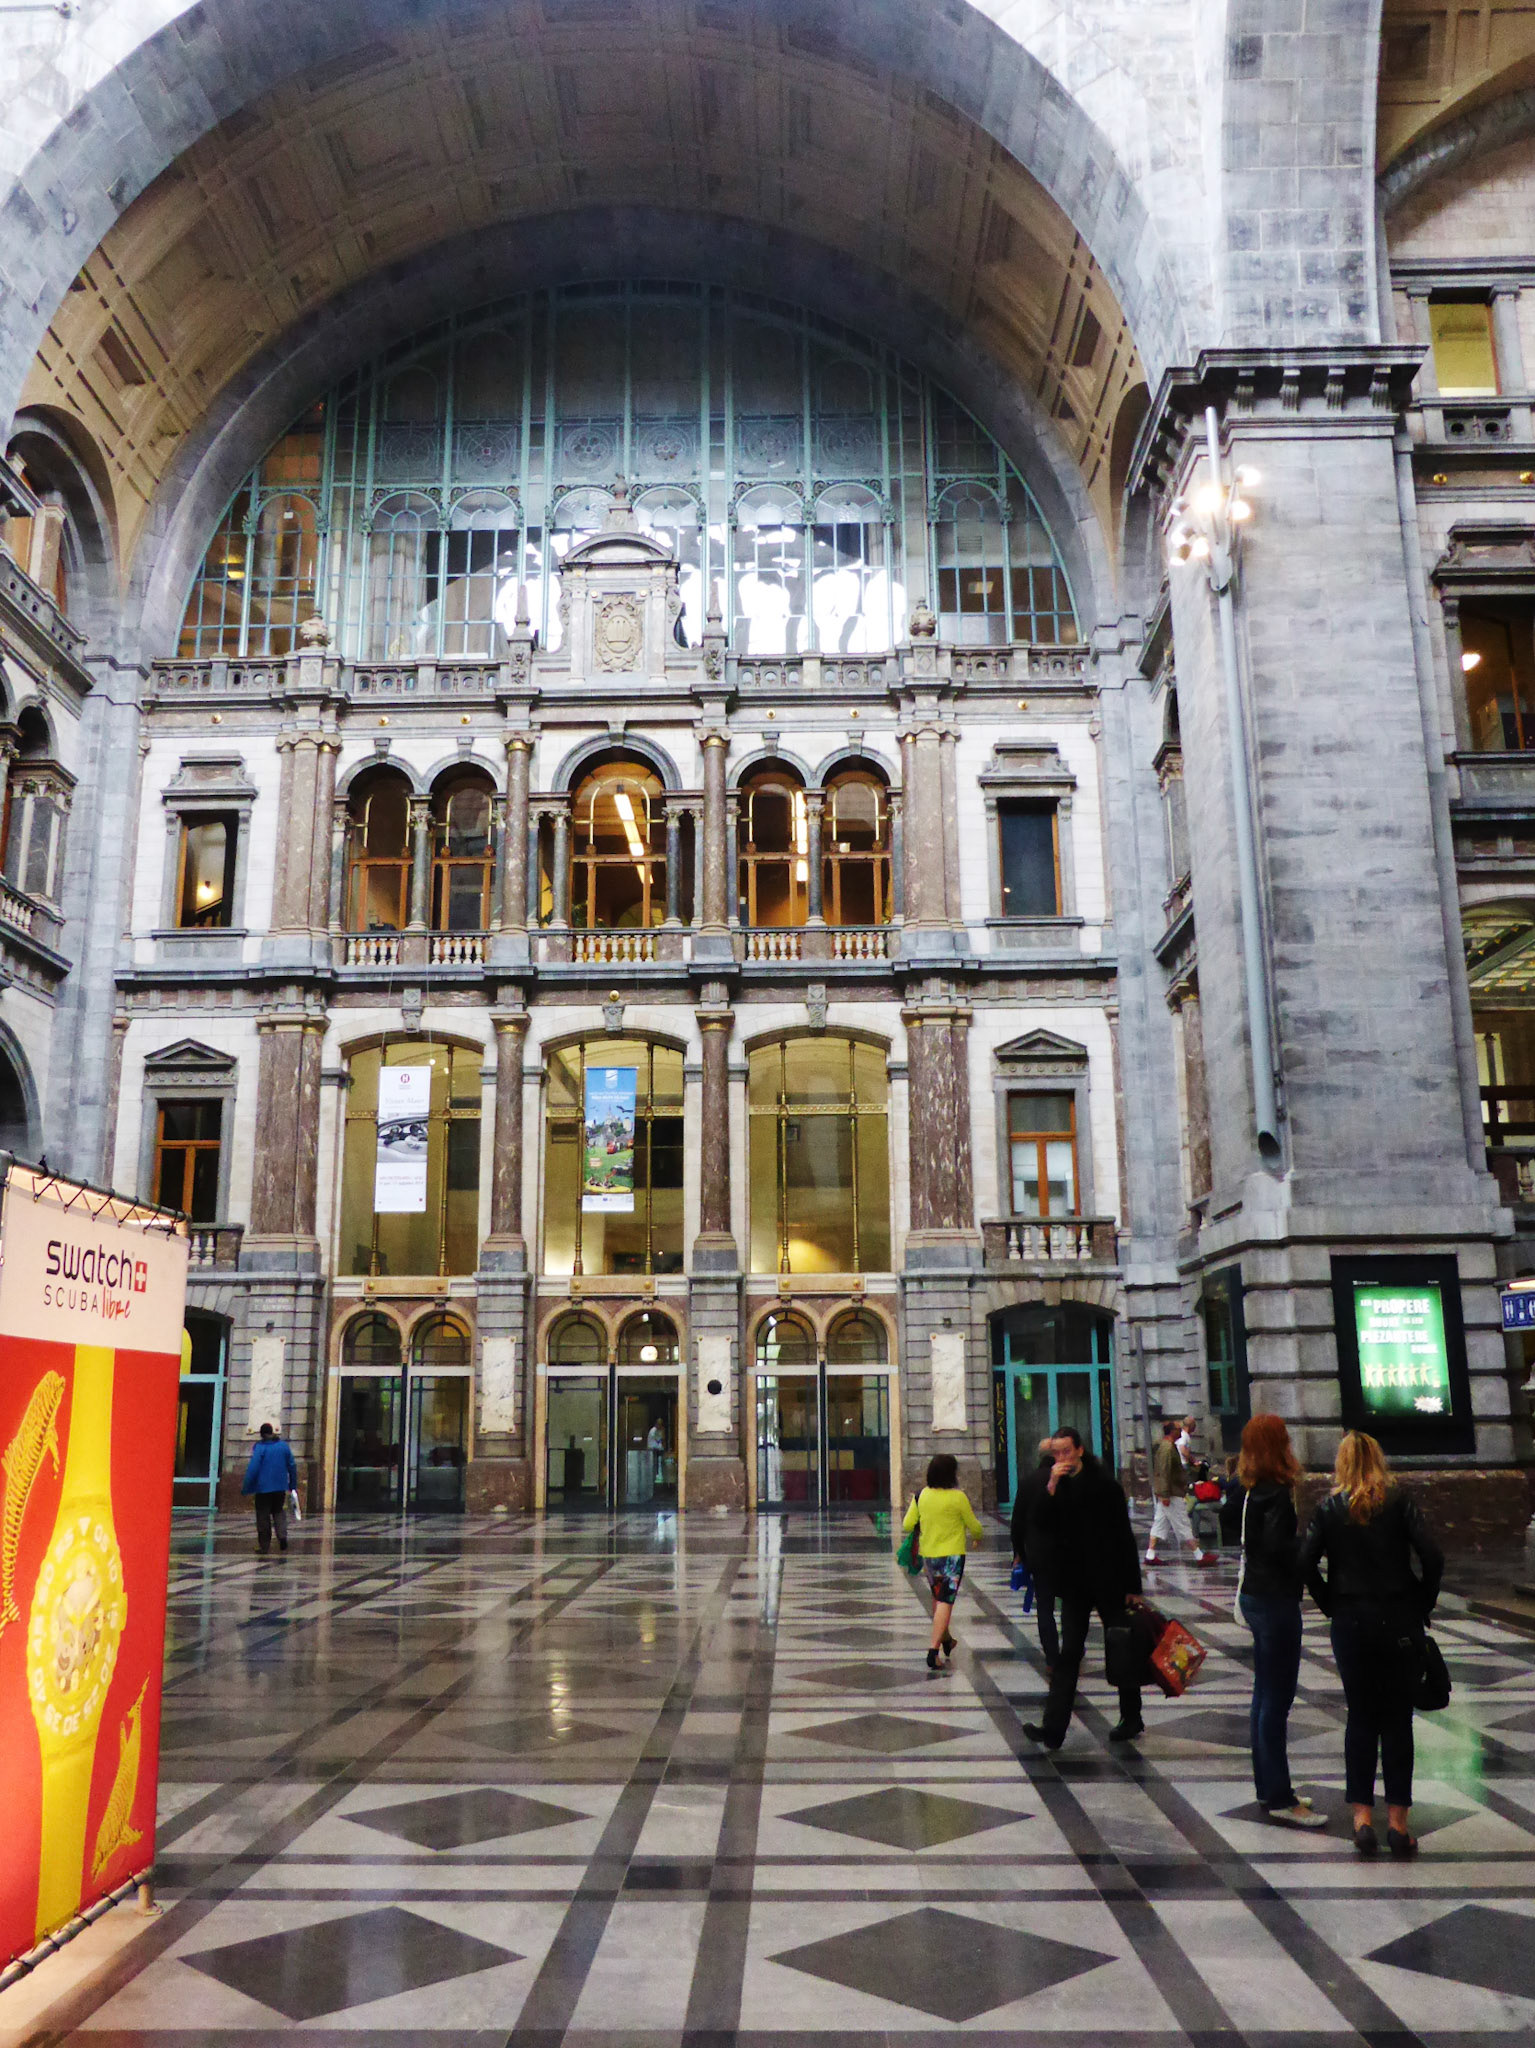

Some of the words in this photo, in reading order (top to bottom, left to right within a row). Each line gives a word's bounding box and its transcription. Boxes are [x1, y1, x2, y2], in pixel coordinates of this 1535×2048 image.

[46, 1240, 133, 1290] swatch
[43, 1284, 99, 1314] SCUBA
[101, 1286, 132, 1320] libre
